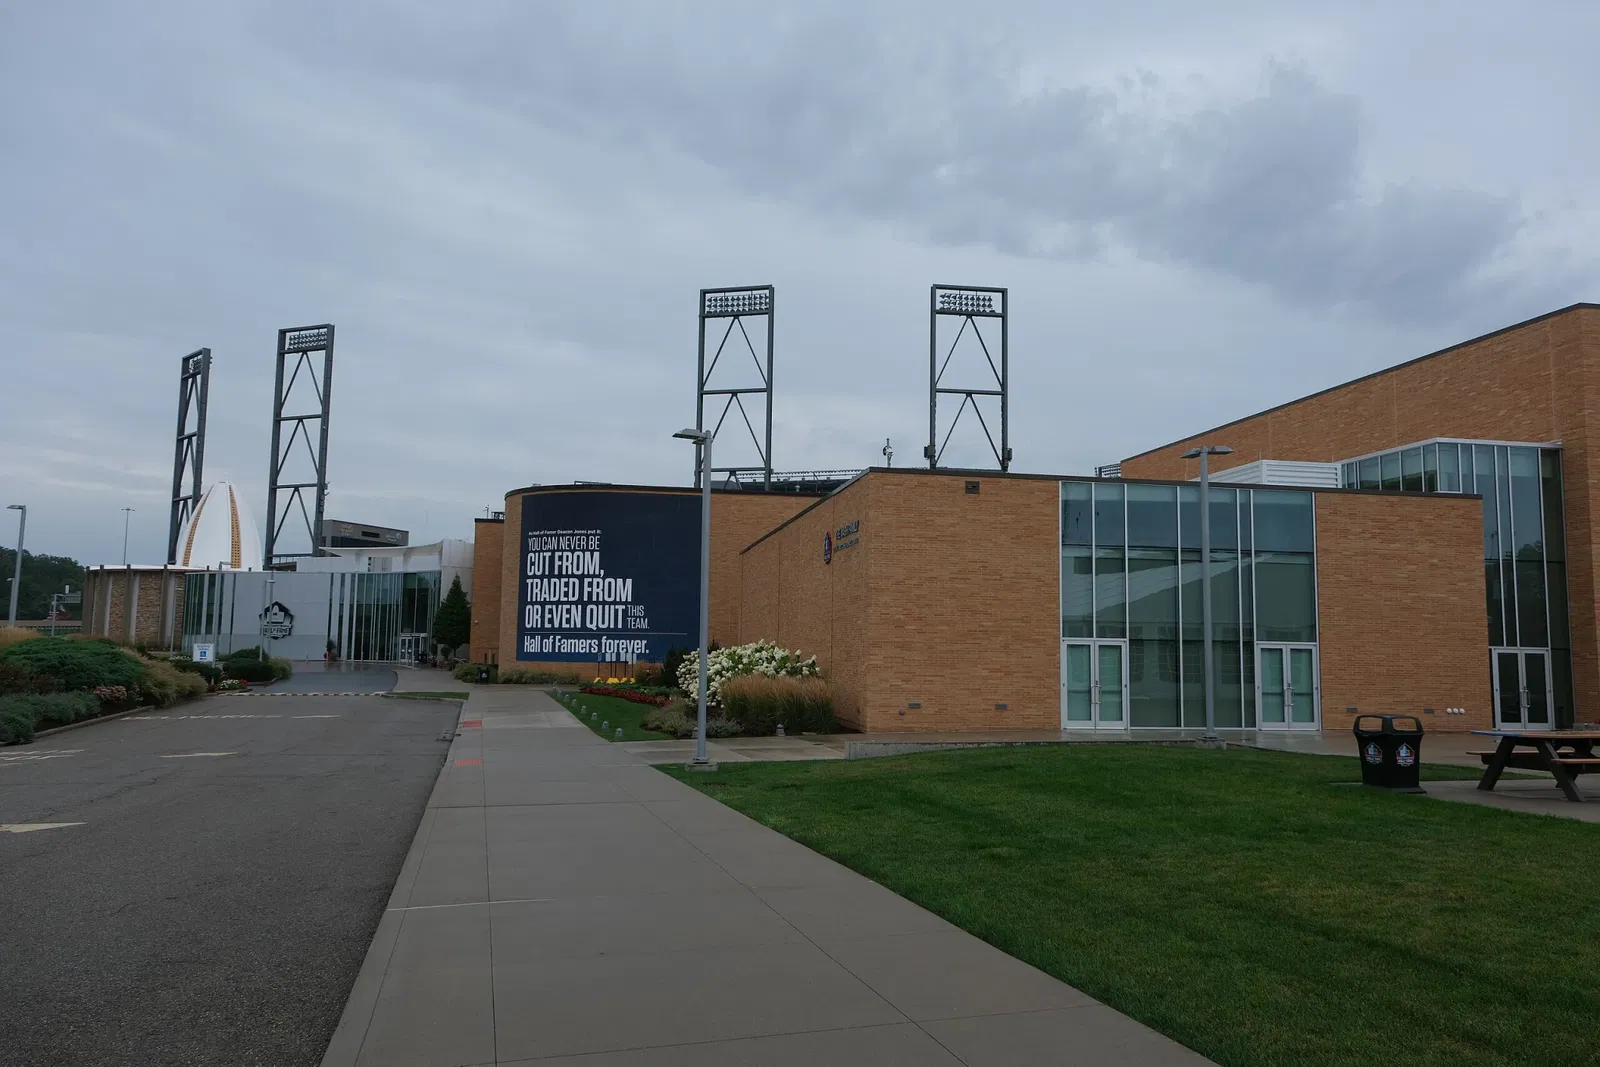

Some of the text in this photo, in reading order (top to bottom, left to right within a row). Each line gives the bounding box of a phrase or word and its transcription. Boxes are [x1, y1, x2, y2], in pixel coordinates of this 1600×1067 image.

[528, 536, 600, 551] YOU CAN NEVER BE
[527, 551, 604, 577] CUT FROM,
[526, 578, 632, 602] TRADED FROM
[525, 604, 644, 630] OR EVEN QUIT THIS
[627, 618, 650, 629] TEAM.
[524, 636, 649, 654] Hall of Famers forever.
